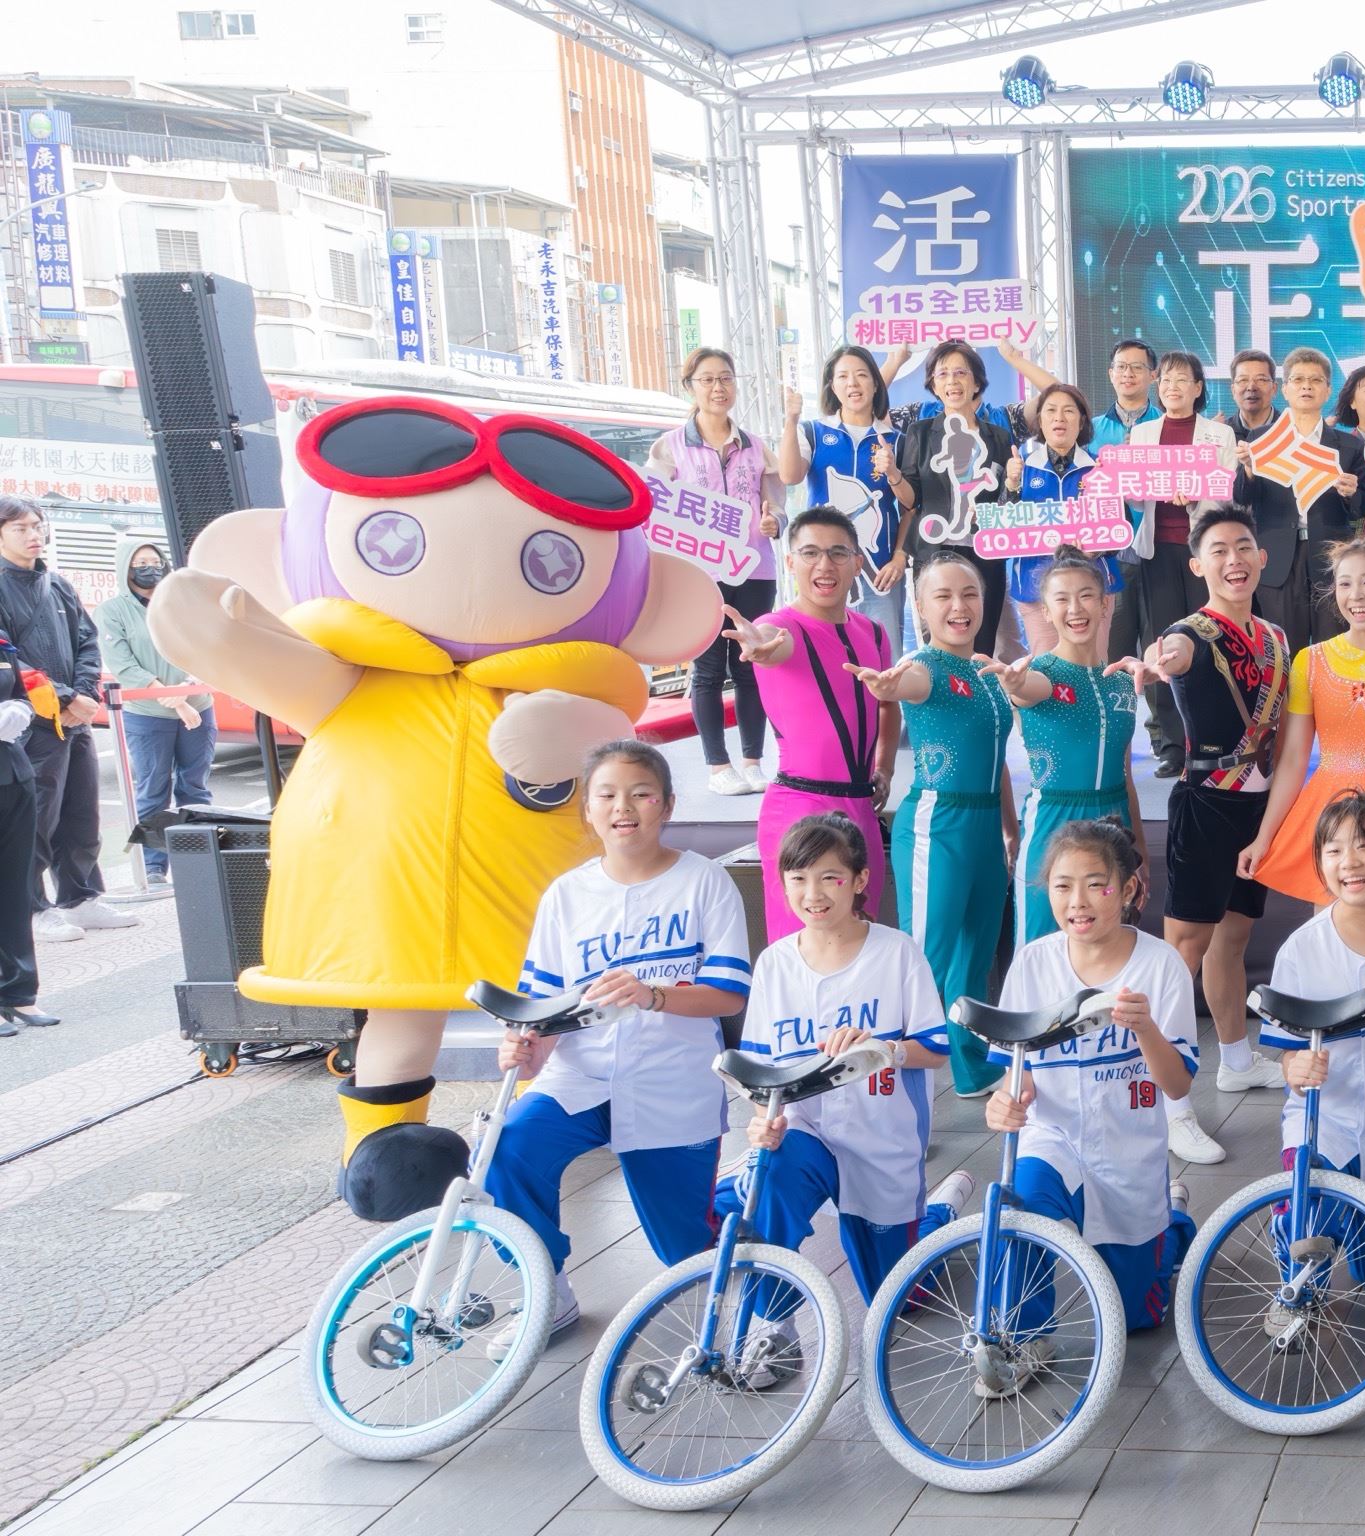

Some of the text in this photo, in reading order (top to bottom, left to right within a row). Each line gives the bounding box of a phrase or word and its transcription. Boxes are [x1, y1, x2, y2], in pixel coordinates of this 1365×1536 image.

[1285, 168, 1365, 188] Citizens
[1177, 165, 1276, 223] 2026
[1086, 469, 1232, 498] 全民運動會
[976, 497, 1119, 530] 歡迎來桃園
[577, 910, 689, 972] FU-AN
[773, 998, 879, 1052] FU-AN
[868, 1067, 896, 1096] 15
[1128, 1080, 1157, 1110] 19
